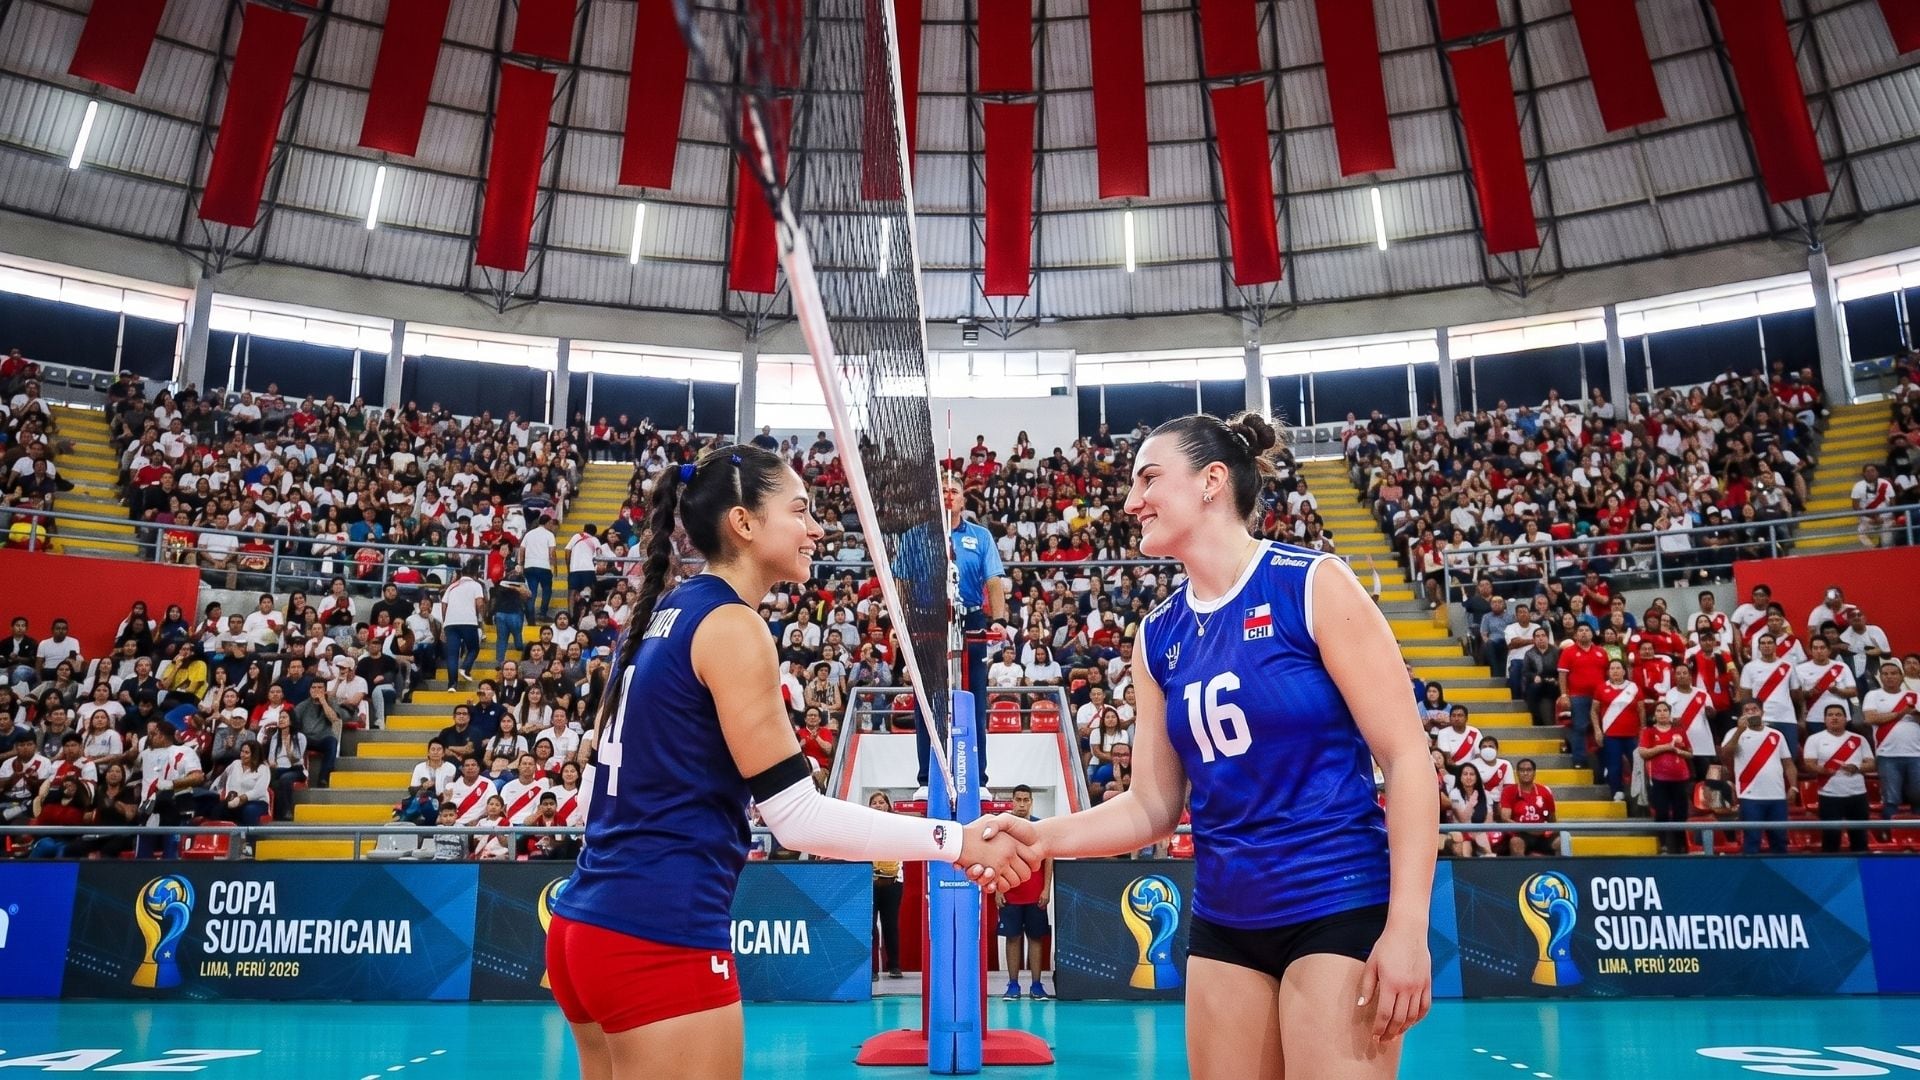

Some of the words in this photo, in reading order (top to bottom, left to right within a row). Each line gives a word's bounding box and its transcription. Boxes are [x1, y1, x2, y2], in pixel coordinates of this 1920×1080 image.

[1247, 626, 1269, 639] CHI
[1183, 671, 1253, 763] 16
[208, 880, 276, 915] COPA
[1590, 876, 1663, 911] COPA
[203, 919, 412, 954] SUDAMERICANA
[730, 919, 810, 955] ICANA
[1594, 914, 1810, 951] SUDAMERICANA
[200, 961, 231, 979] LIMA,
[235, 959, 266, 977] PERÚ
[269, 961, 299, 977] 2026
[711, 955, 730, 980] 4
[1598, 957, 1632, 975] LIMA,
[1634, 954, 1665, 974] PERÚ
[1668, 957, 1700, 974] 2026
[0, 1049, 262, 1072] AZ
